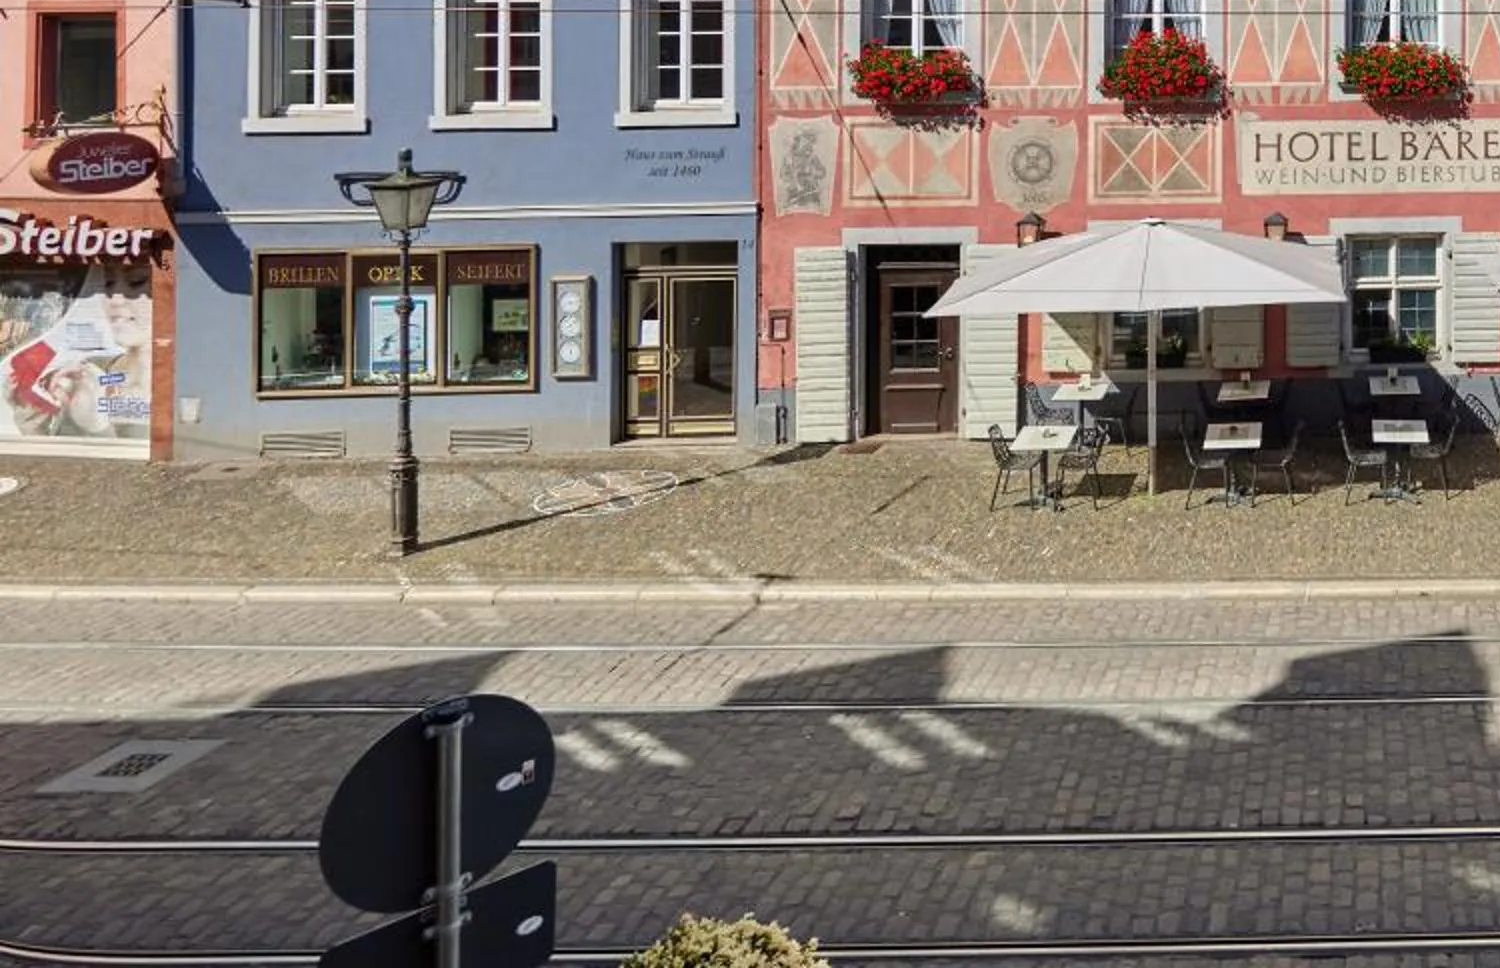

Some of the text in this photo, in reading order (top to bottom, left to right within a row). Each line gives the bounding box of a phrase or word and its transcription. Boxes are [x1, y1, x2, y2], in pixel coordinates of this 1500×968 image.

[1254, 131, 1389, 163] HOTEL
[60, 158, 153, 183] Steiber
[0, 208, 153, 257] Steiber
[268, 266, 340, 283] BRILLEN
[368, 265, 425, 282] OPTK
[456, 263, 526, 280] SEIFERT
